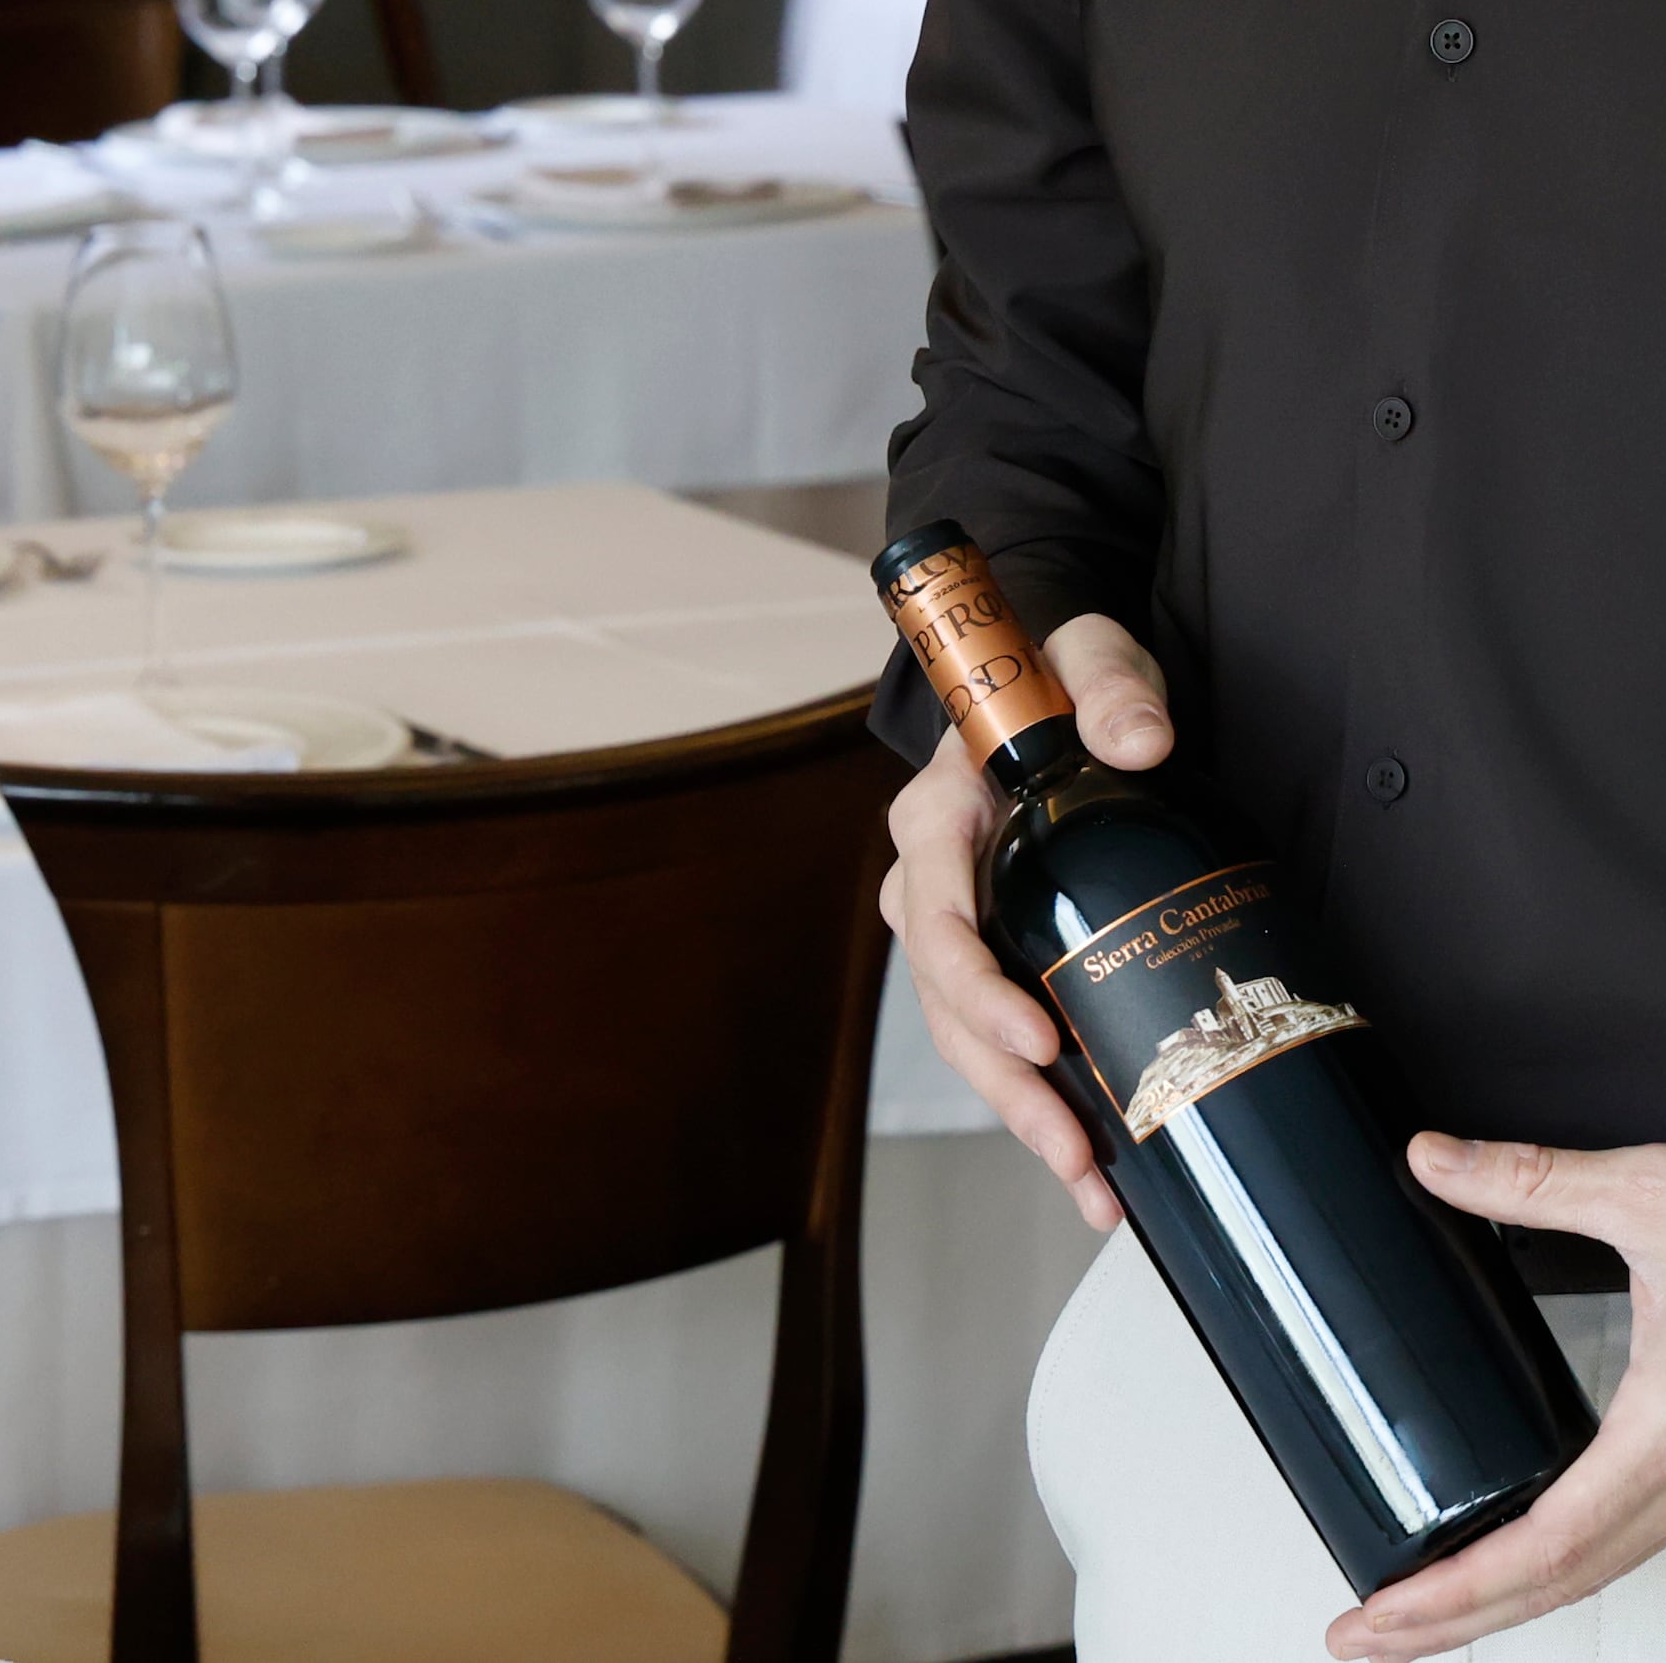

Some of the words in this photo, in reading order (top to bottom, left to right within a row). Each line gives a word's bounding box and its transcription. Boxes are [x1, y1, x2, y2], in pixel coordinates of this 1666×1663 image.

[1082, 930, 1159, 983] Sierra
[1159, 879, 1271, 936] Cantabria
[1145, 938, 1199, 970] Colección
[1199, 917, 1242, 945] Privada
